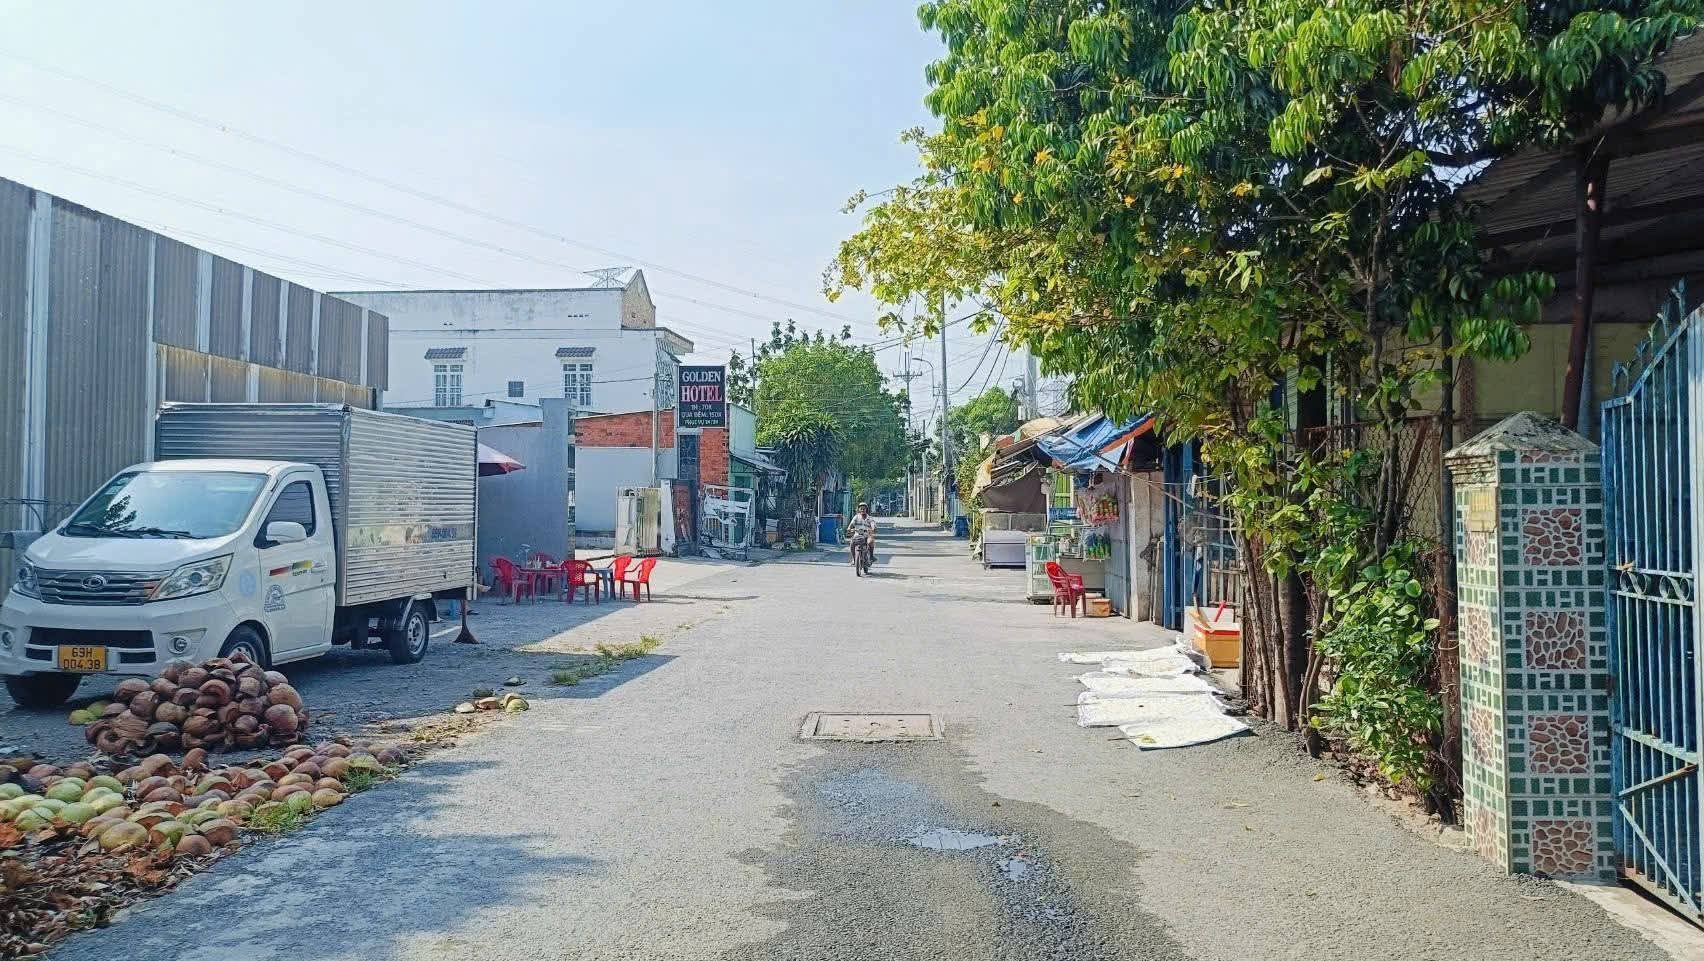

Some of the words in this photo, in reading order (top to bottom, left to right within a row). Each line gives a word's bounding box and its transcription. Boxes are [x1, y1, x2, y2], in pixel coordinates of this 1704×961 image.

[682, 371, 721, 382] GOLDEN
[680, 385, 722, 402] HOTEL
[72, 648, 93, 657] 69H
[64, 659, 101, 669] 004.38
